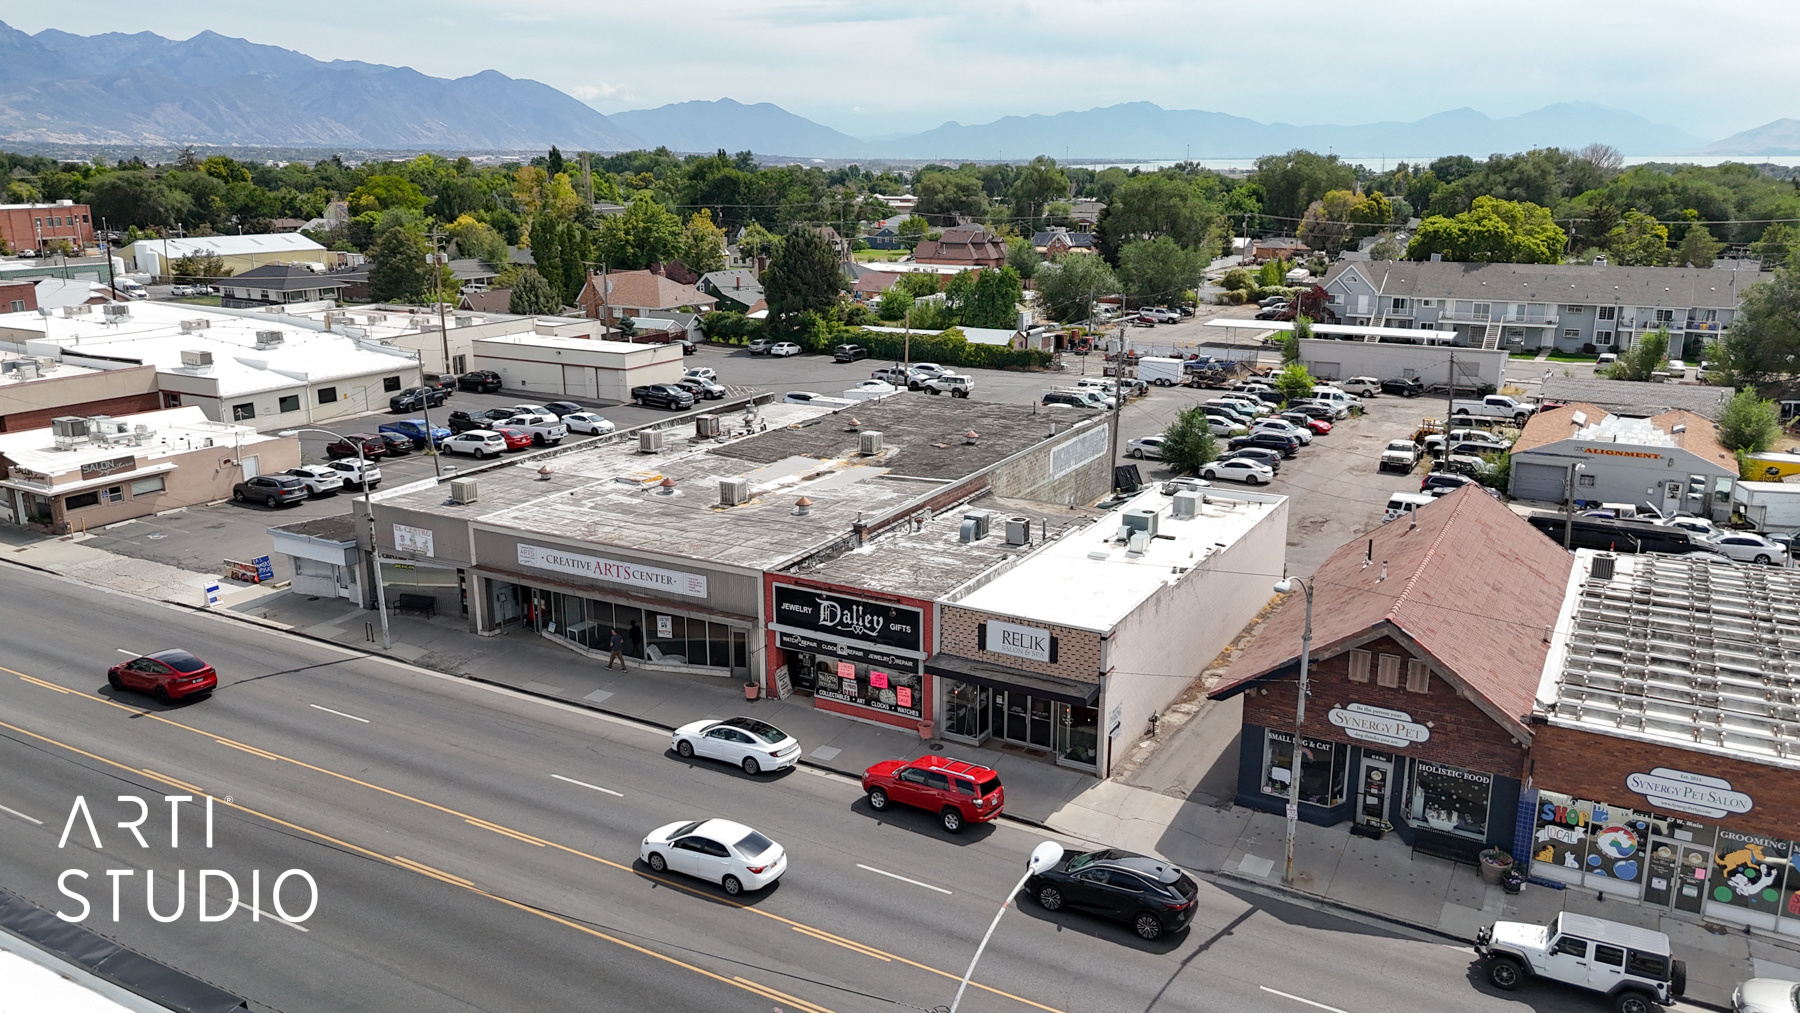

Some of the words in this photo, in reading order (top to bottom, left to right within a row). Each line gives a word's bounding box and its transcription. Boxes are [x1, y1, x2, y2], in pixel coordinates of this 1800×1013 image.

[1584, 448, 1660, 459] ALIGNMENT
[14, 466, 32, 476] SALON
[82, 460, 114, 474] SALON
[404, 527, 431, 537] CENTRO
[520, 549, 535, 557] ARTS
[546, 554, 592, 571] CREATIVE
[593, 561, 631, 580] ARTS
[632, 569, 673, 586] CENTER
[781, 602, 812, 614] JEWELRY
[815, 597, 884, 636] Dalley
[889, 623, 912, 633] GIFTS
[801, 640, 818, 648] REPAIR
[1002, 629, 1045, 652] RELIK
[822, 643, 837, 652] CLOCK
[846, 649, 864, 657] REPAIR
[1001, 644, 1023, 654] SALON
[1031, 651, 1045, 659] SPA
[868, 653, 890, 662] JEWELRY
[895, 658, 913, 667] REPAIR
[818, 689, 850, 702] COLLECTABLES
[857, 697, 866, 705] ART
[871, 700, 889, 710] CLOCKS
[897, 706, 919, 717] WATCHES
[1334, 711, 1392, 733] SYNERGY
[1395, 723, 1422, 739] PET
[1268, 732, 1291, 743] SMALL
[1316, 742, 1331, 751] CAT
[1419, 763, 1462, 778] HOLISTIC
[1463, 772, 1490, 784] FOOD
[1631, 776, 1681, 796] SYNERGY
[1683, 786, 1708, 801] PET
[1707, 791, 1747, 809] SALON
[1541, 803, 1589, 827] SHOP
[1686, 820, 1704, 829] Main
[1546, 825, 1576, 843] LOCAL
[1720, 830, 1787, 850] GROOMING
